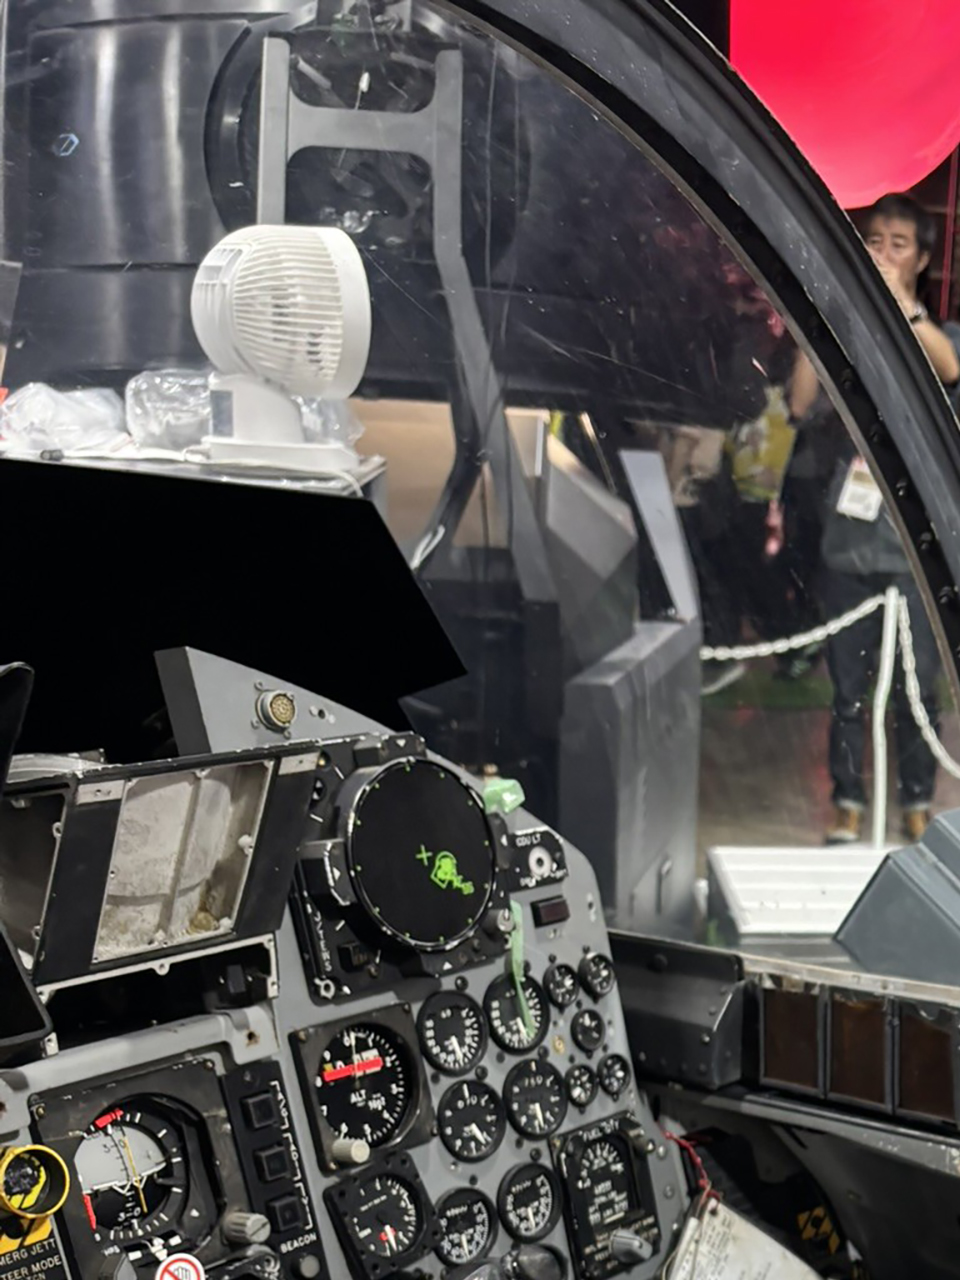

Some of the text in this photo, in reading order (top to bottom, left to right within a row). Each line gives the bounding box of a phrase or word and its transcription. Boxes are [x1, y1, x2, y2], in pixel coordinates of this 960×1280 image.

[0, 1238, 56, 1266] MERG JETT
[280, 1233, 317, 1254] BEACON
[31, 1254, 62, 1273] MODE
